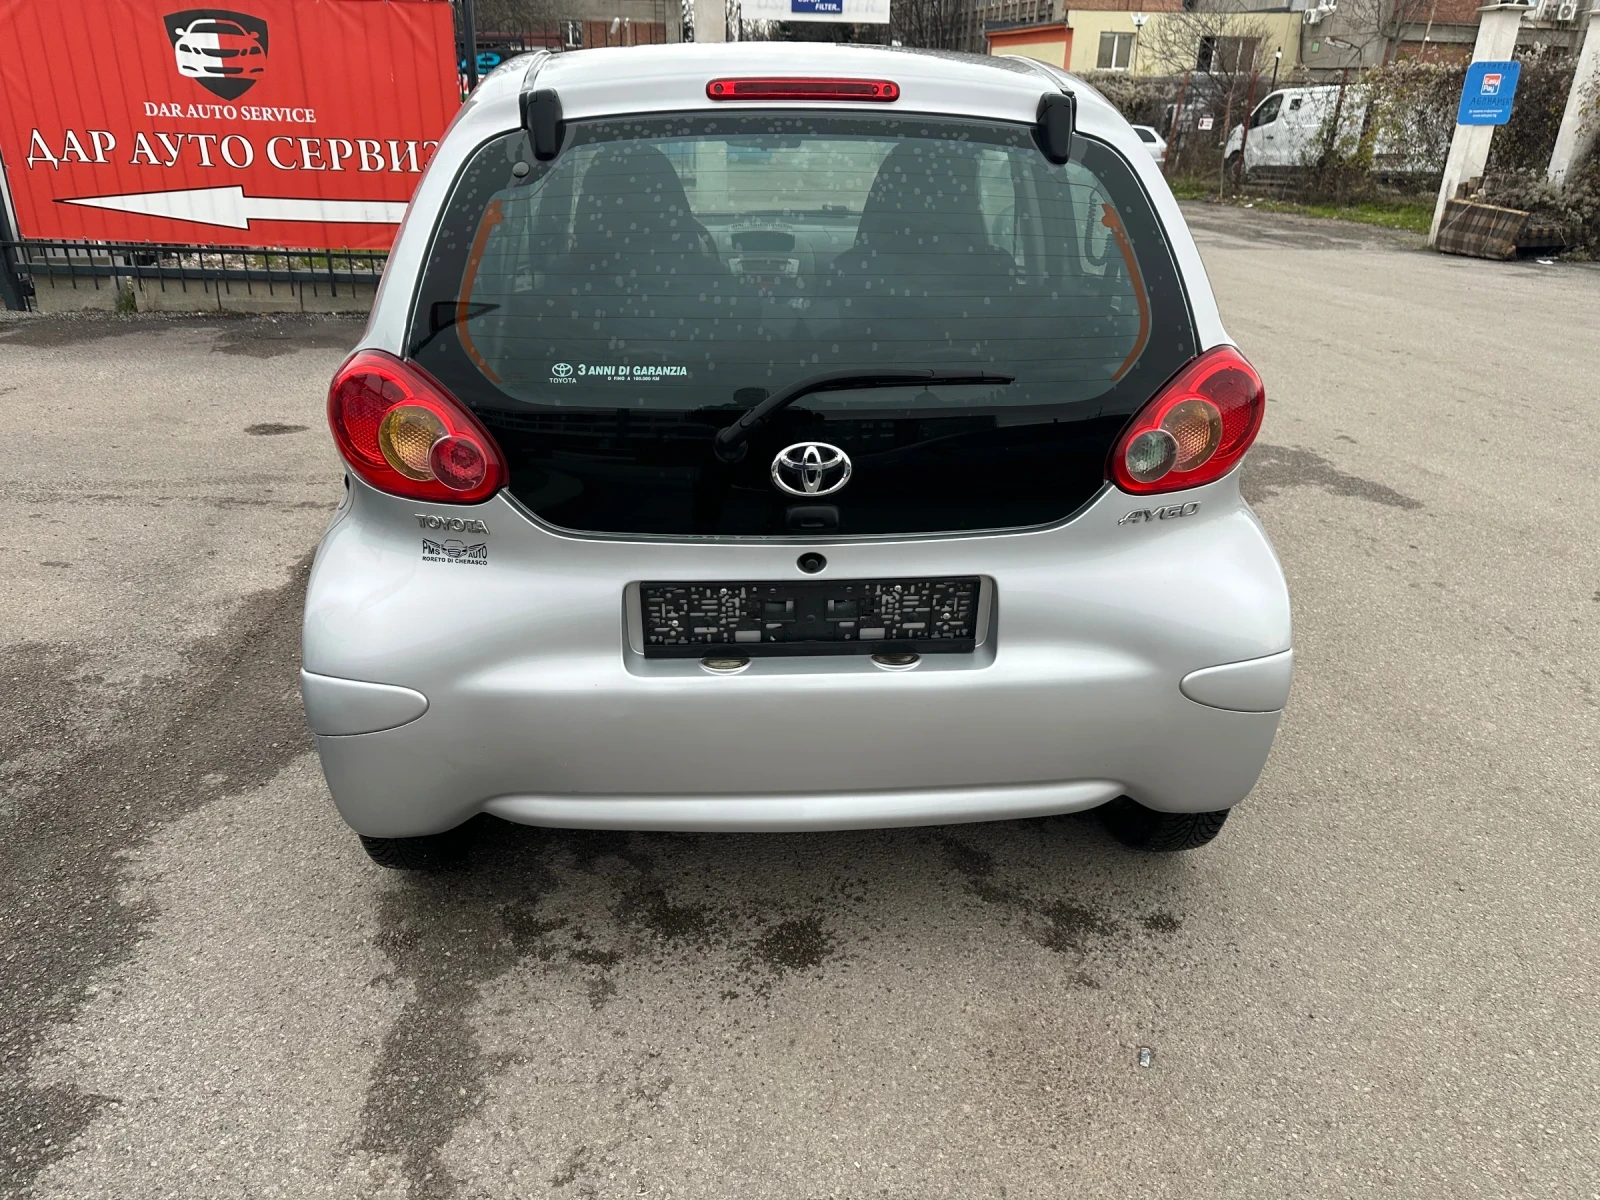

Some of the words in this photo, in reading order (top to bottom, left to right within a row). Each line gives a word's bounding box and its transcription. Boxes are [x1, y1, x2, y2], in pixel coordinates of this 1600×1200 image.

[815, 3, 837, 11] FILTER
[1484, 78, 1499, 86] Easy
[144, 102, 184, 118] DAR
[187, 103, 237, 120] AUTO
[241, 105, 316, 123] SERVICE
[26, 128, 116, 171] ДАР
[129, 131, 254, 169] АУТО
[577, 363, 586, 376] 3
[588, 365, 615, 376] ANNI
[618, 365, 630, 376] DI
[633, 365, 687, 376] GARANZIA
[1118, 500, 1202, 525] AYGO
[415, 513, 490, 534] TOYOTA
[422, 540, 441, 556] PMS
[468, 545, 488, 559] AUTO
[454, 557, 488, 565] CHERASCO
